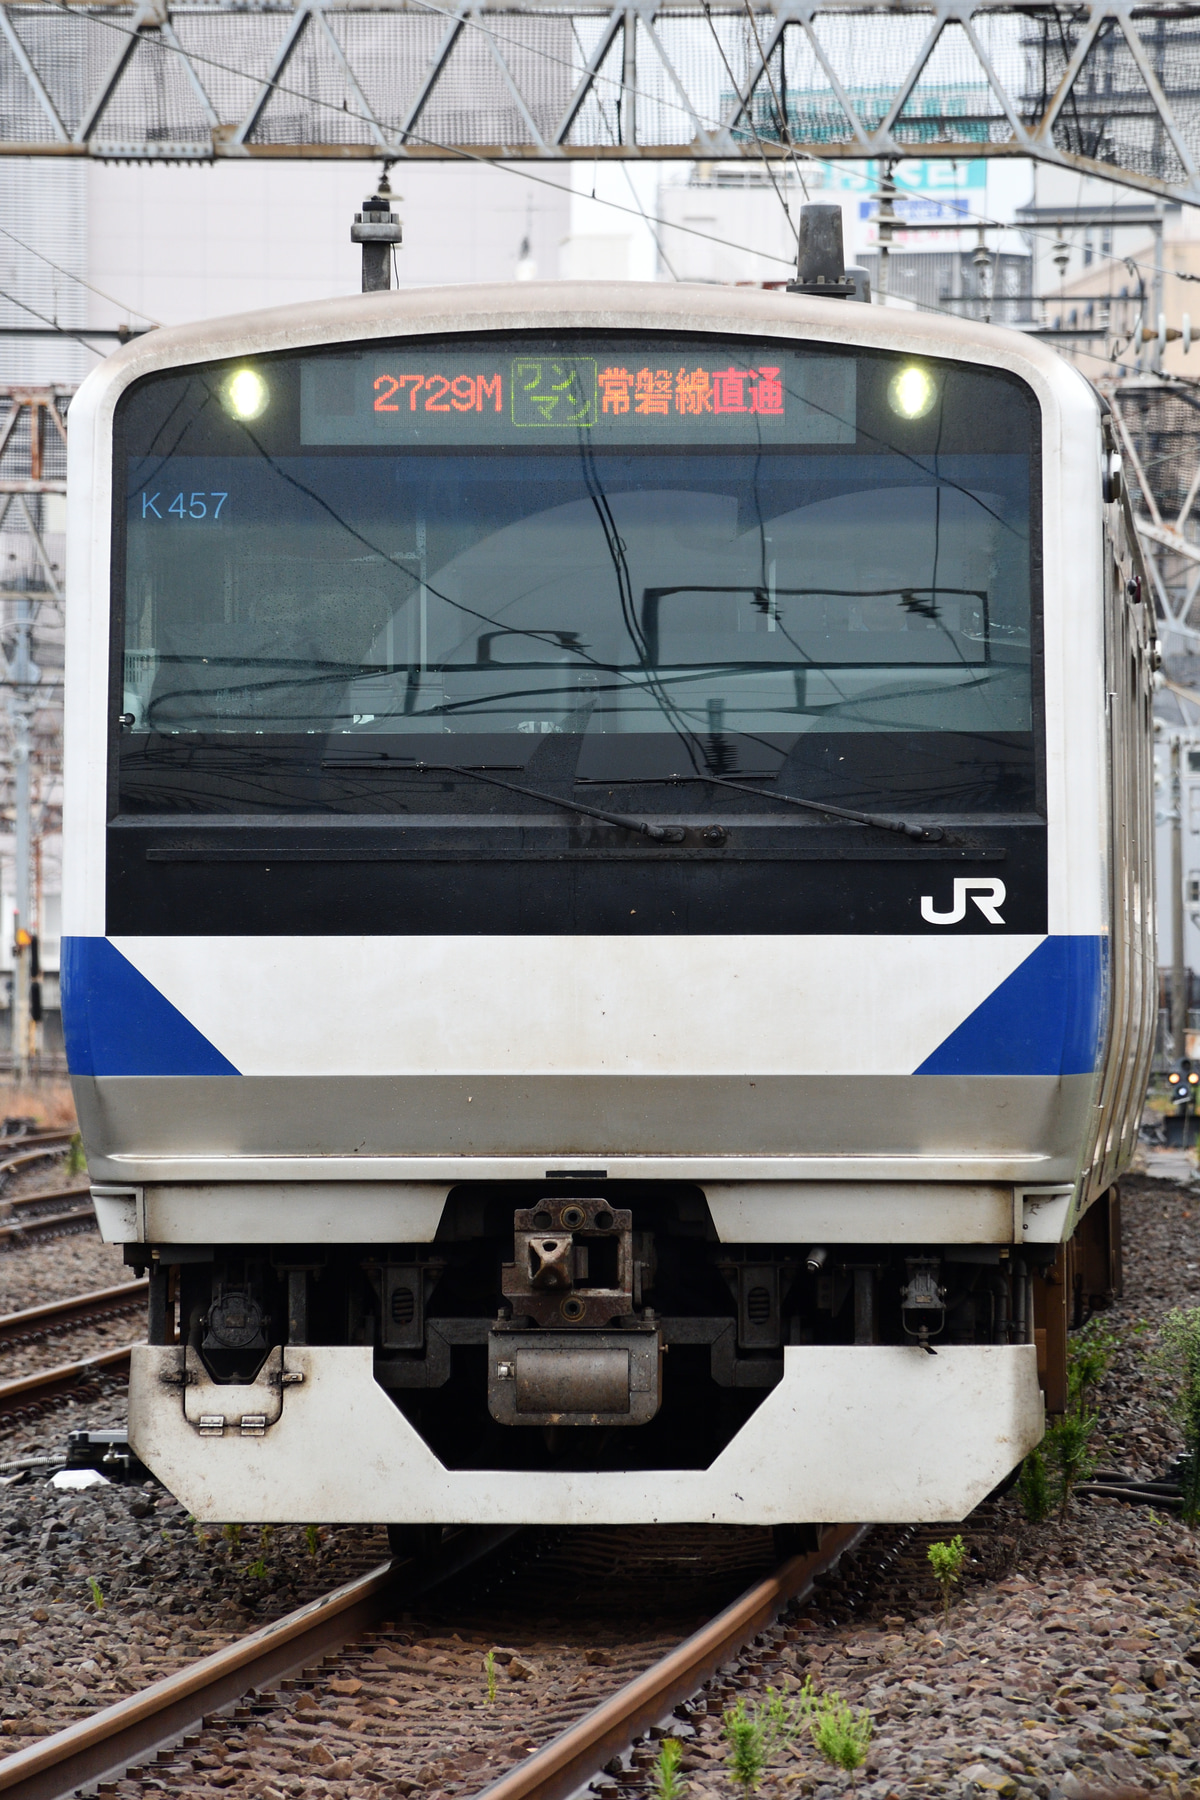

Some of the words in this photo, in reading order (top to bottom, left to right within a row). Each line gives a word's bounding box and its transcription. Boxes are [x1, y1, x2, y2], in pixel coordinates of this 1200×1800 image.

[374, 373, 502, 412] 2729M
[517, 364, 576, 391] ワン
[598, 367, 784, 415] 常磐線直通
[530, 394, 591, 421] マン
[920, 877, 1006, 925] JR
